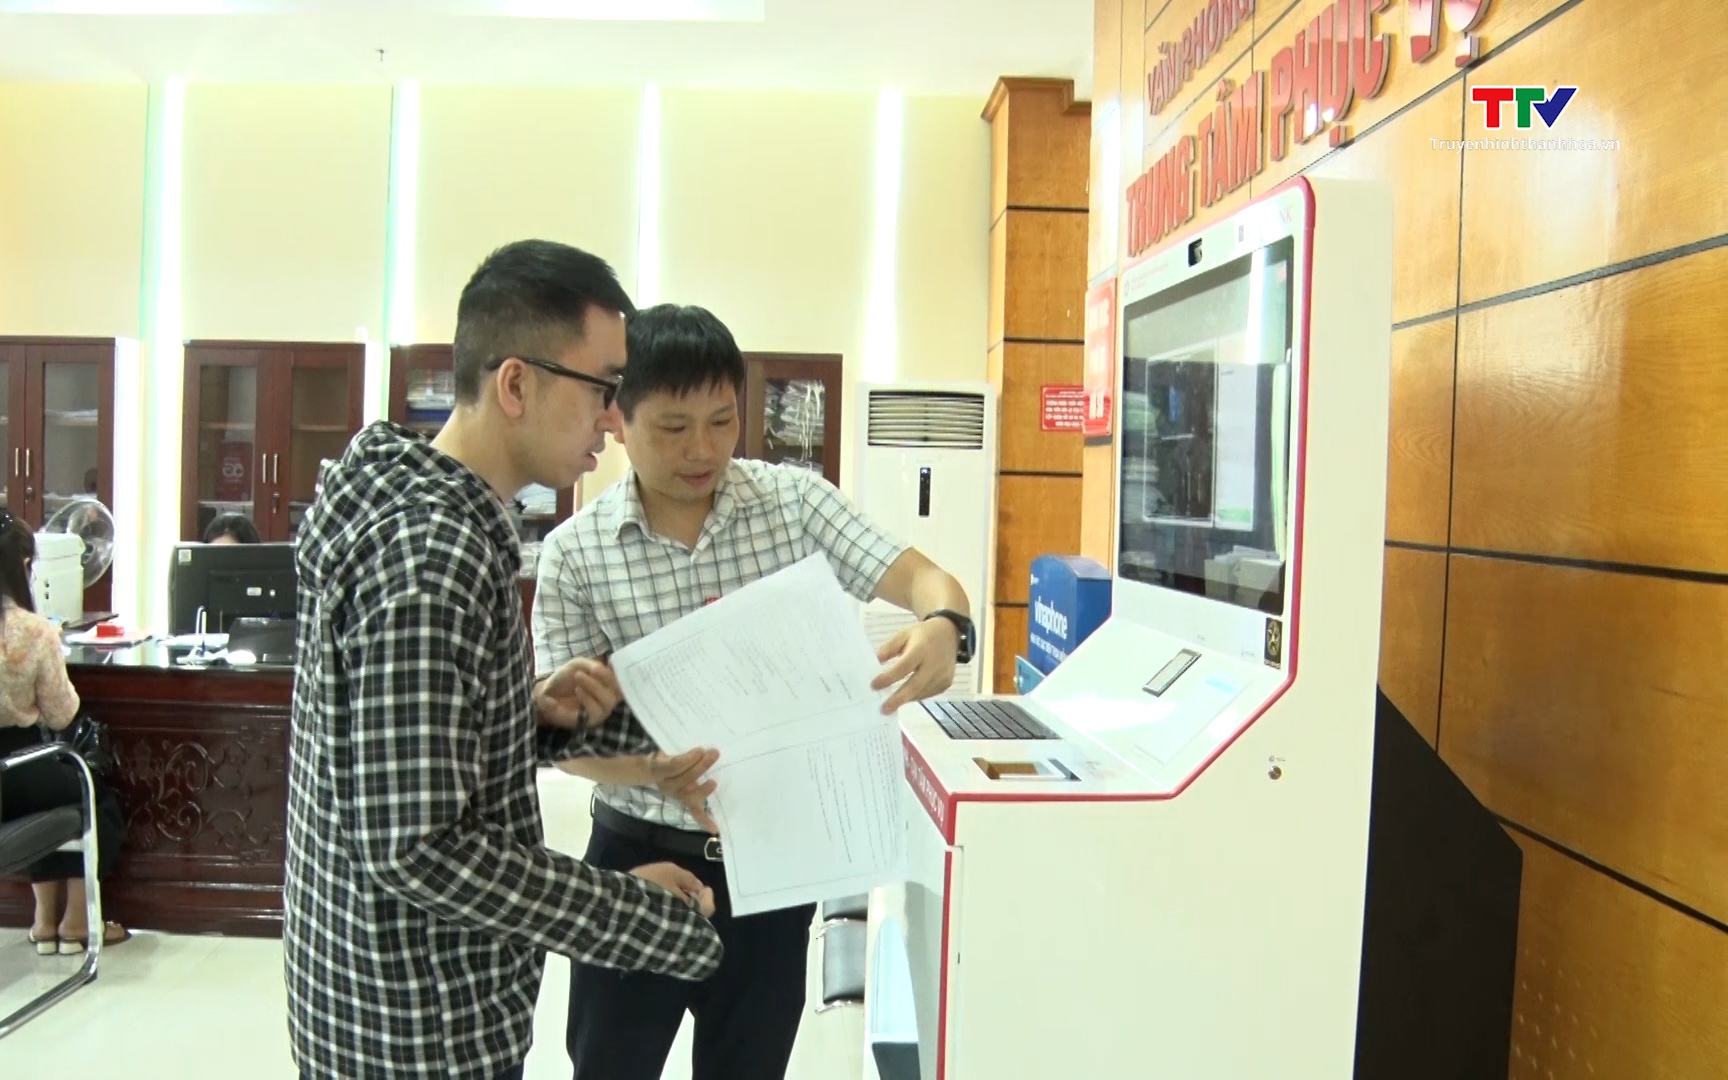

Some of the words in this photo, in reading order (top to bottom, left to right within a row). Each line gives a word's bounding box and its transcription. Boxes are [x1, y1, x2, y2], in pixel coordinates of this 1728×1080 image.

[1126, 134, 1197, 257] TRUNG
[1198, 70, 1266, 208] TÂM
[1271, 0, 1391, 161] PHỤC
